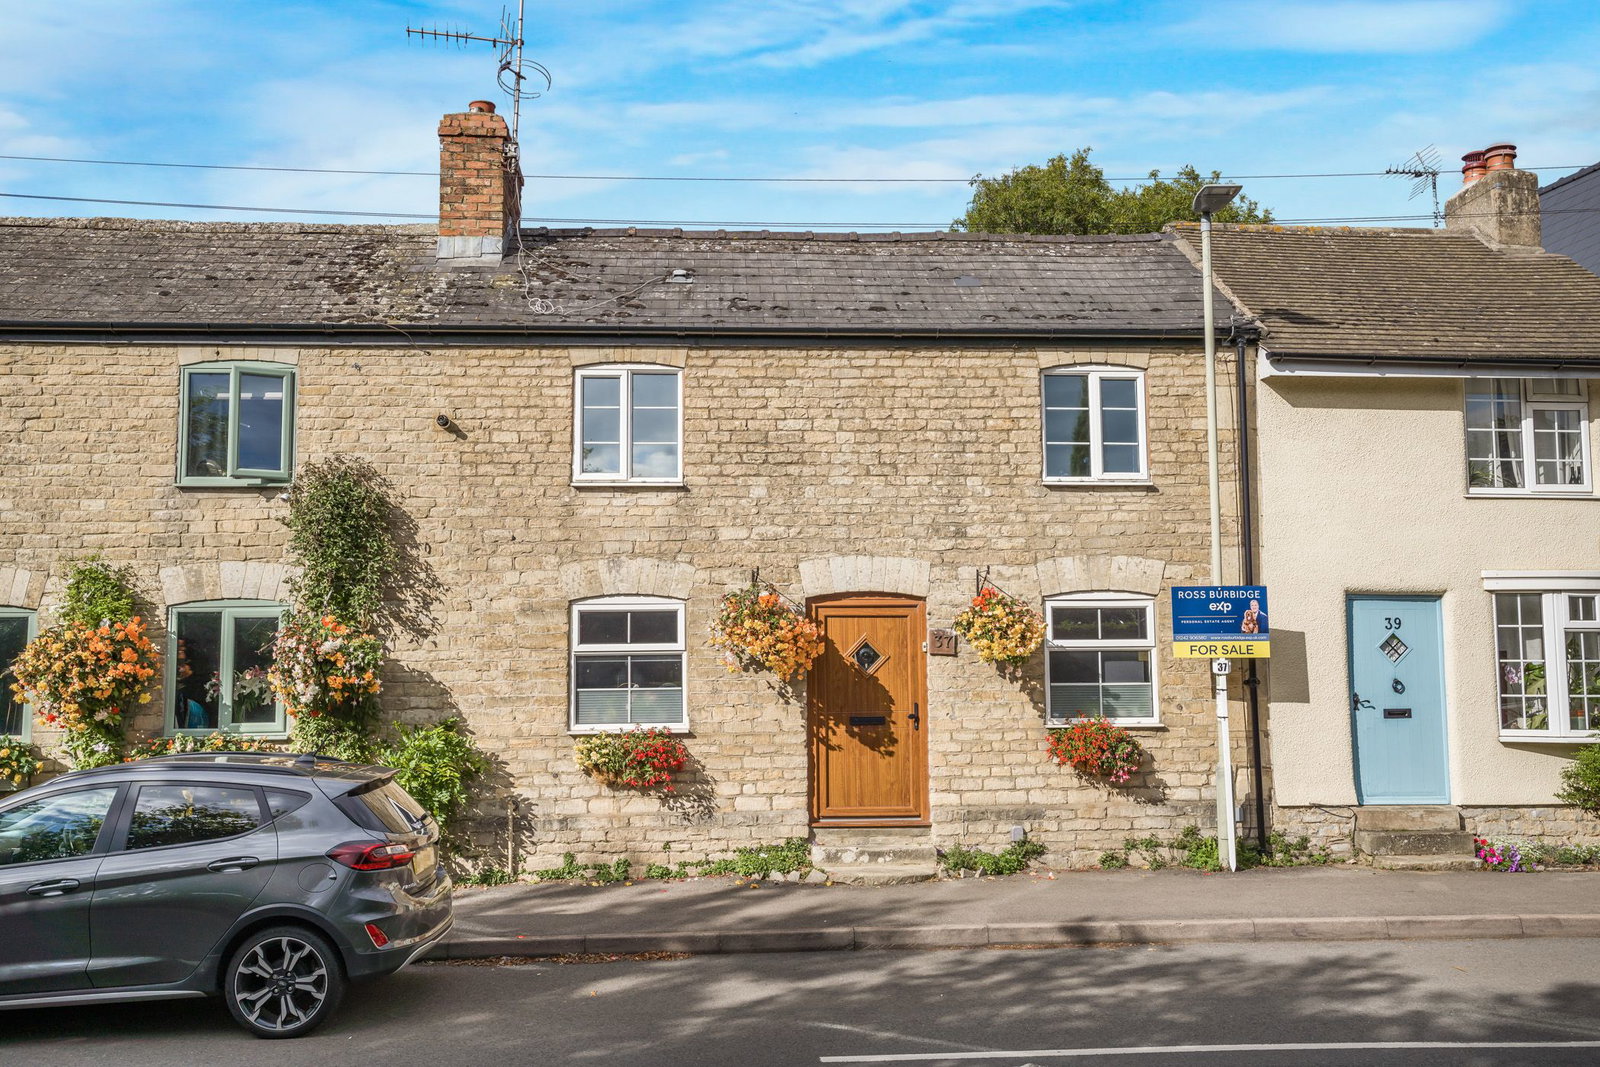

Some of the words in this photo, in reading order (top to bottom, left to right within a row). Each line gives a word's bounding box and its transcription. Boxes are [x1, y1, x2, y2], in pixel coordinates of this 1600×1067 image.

[1178, 590, 1206, 599] ROSS
[1209, 590, 1260, 599] BURBIDGE
[1209, 601, 1232, 613] exp
[1384, 617, 1402, 630] 39
[934, 635, 953, 649] 37
[1190, 645, 1218, 655] FOR
[1221, 645, 1254, 655] SALE
[1217, 663, 1227, 672] 37
